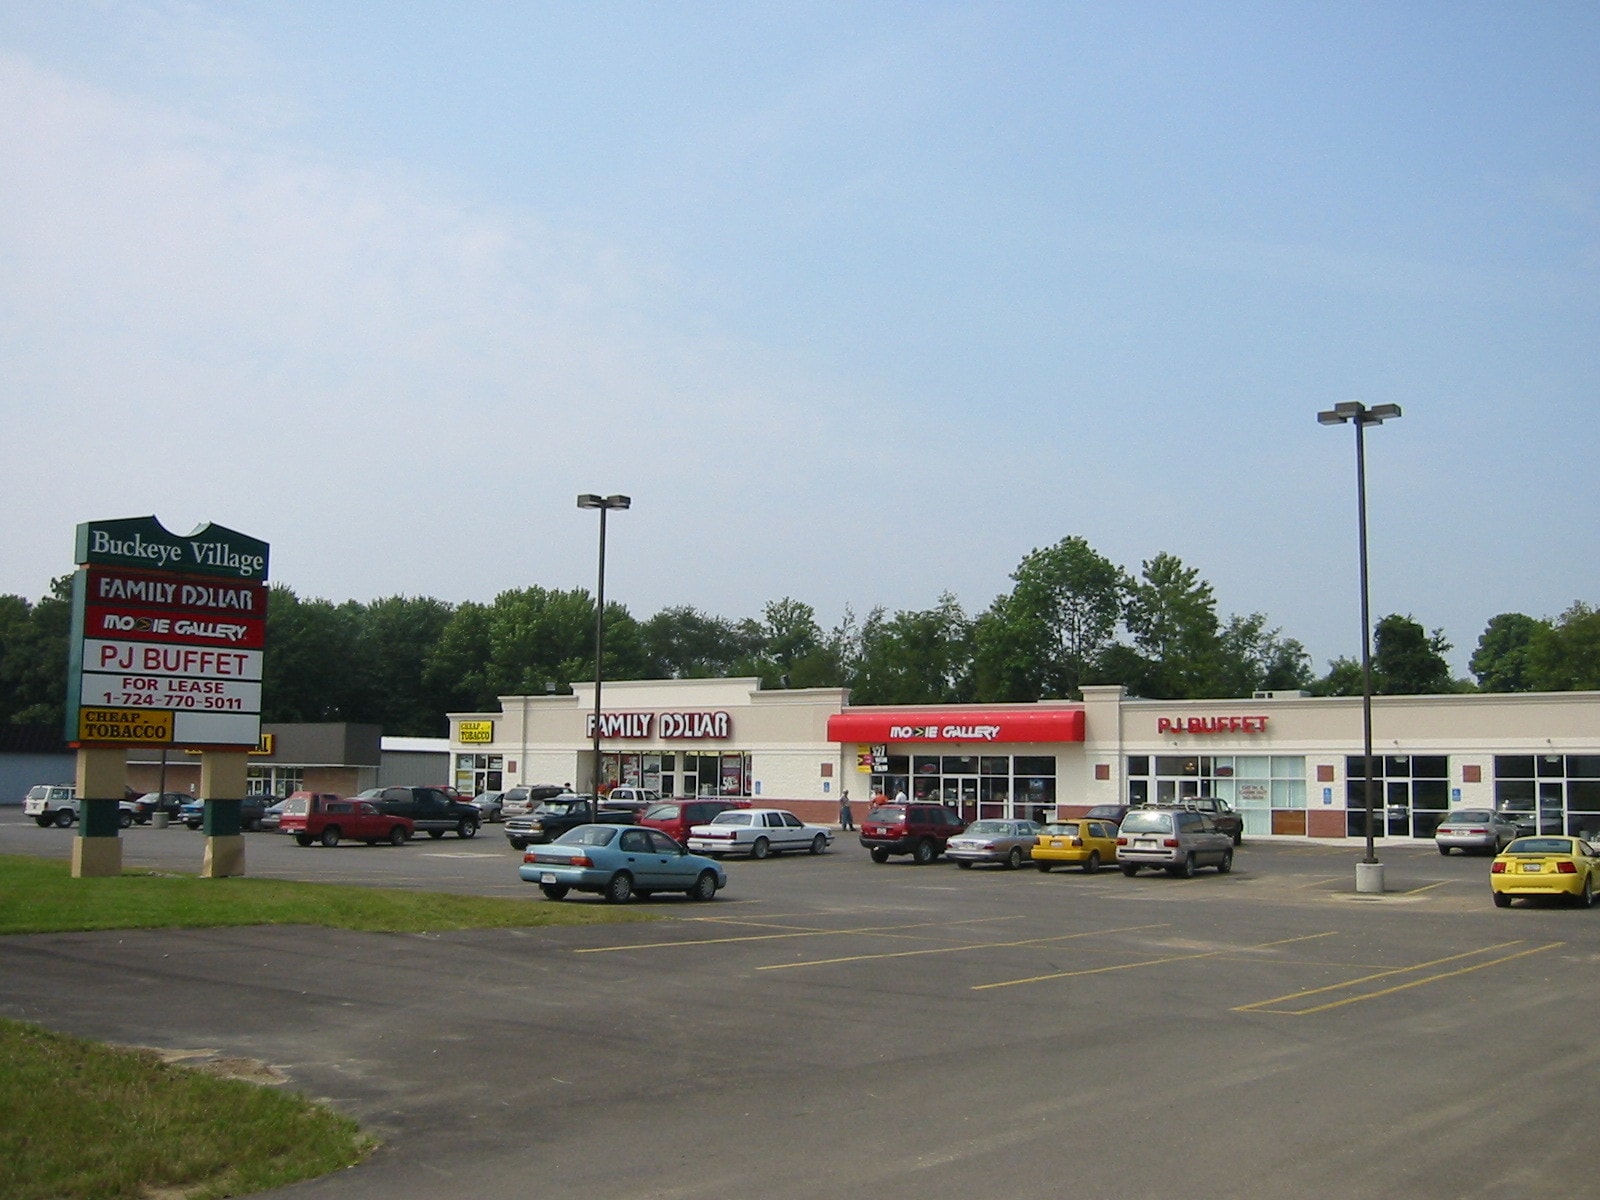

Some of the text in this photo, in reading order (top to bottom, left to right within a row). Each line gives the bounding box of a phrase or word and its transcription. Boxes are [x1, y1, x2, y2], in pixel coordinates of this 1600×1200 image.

[92, 530, 264, 577] Buckeye Village
[100, 577, 252, 611] FAMILY DOLLAR
[174, 620, 247, 642] GALLERY
[101, 645, 249, 676] PJ BUFFET
[122, 677, 224, 694] FOR LEASE
[103, 692, 242, 710] 1-724-770-5011
[85, 711, 141, 723] CHEAP
[587, 711, 730, 738] FAMILY DOLLAR
[1157, 716, 1269, 735] PJ BUFFET
[85, 724, 167, 739] TOBACCO
[942, 725, 1000, 741] GALLERY
